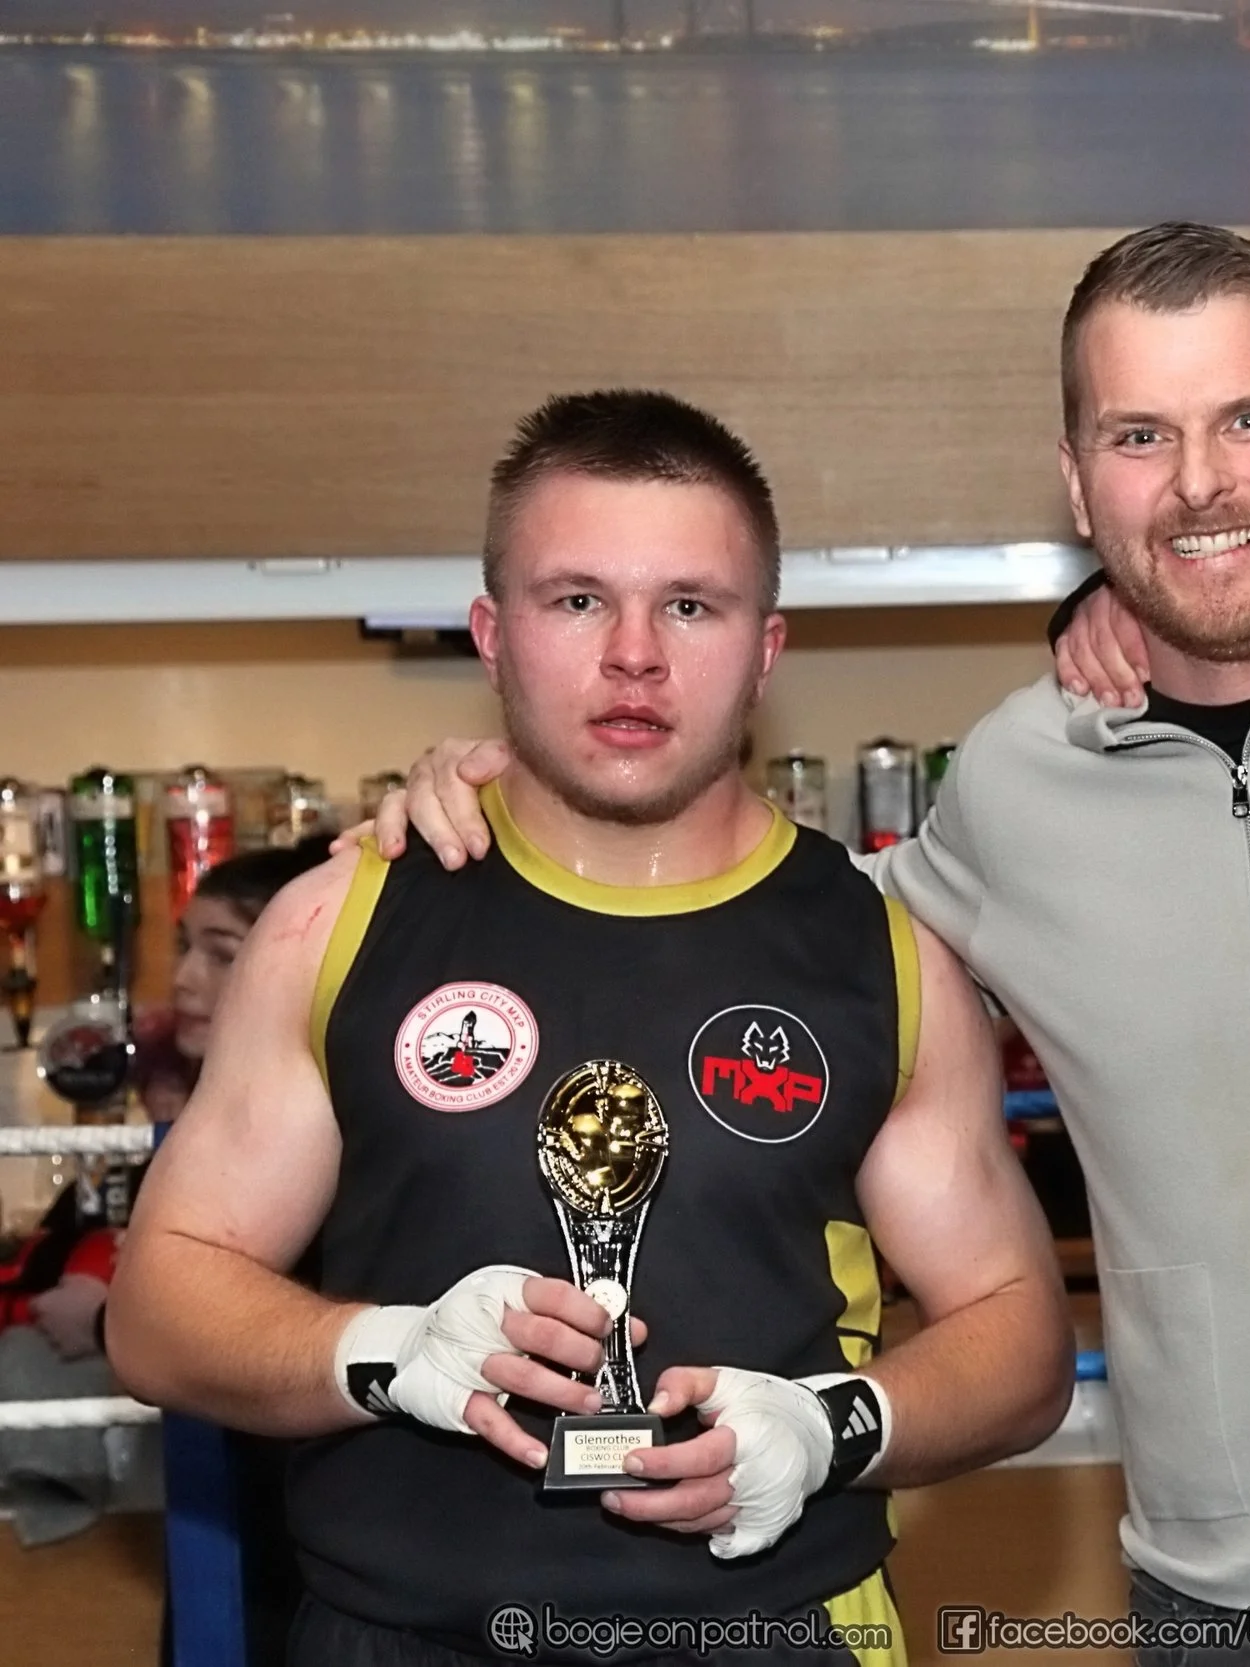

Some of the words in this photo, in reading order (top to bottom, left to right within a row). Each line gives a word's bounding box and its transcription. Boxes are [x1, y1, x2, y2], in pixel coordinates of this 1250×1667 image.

[418, 990, 476, 1020] STIRLING
[480, 991, 508, 1008] CITY
[506, 1006, 525, 1029] MXP
[404, 1056, 429, 1094] AMATEUR
[429, 1090, 464, 1104] BOXING
[466, 1088, 493, 1102] CLUB
[493, 1077, 510, 1091] EST
[702, 1055, 822, 1112] MXP
[575, 1434, 641, 1445] Glenrothes
